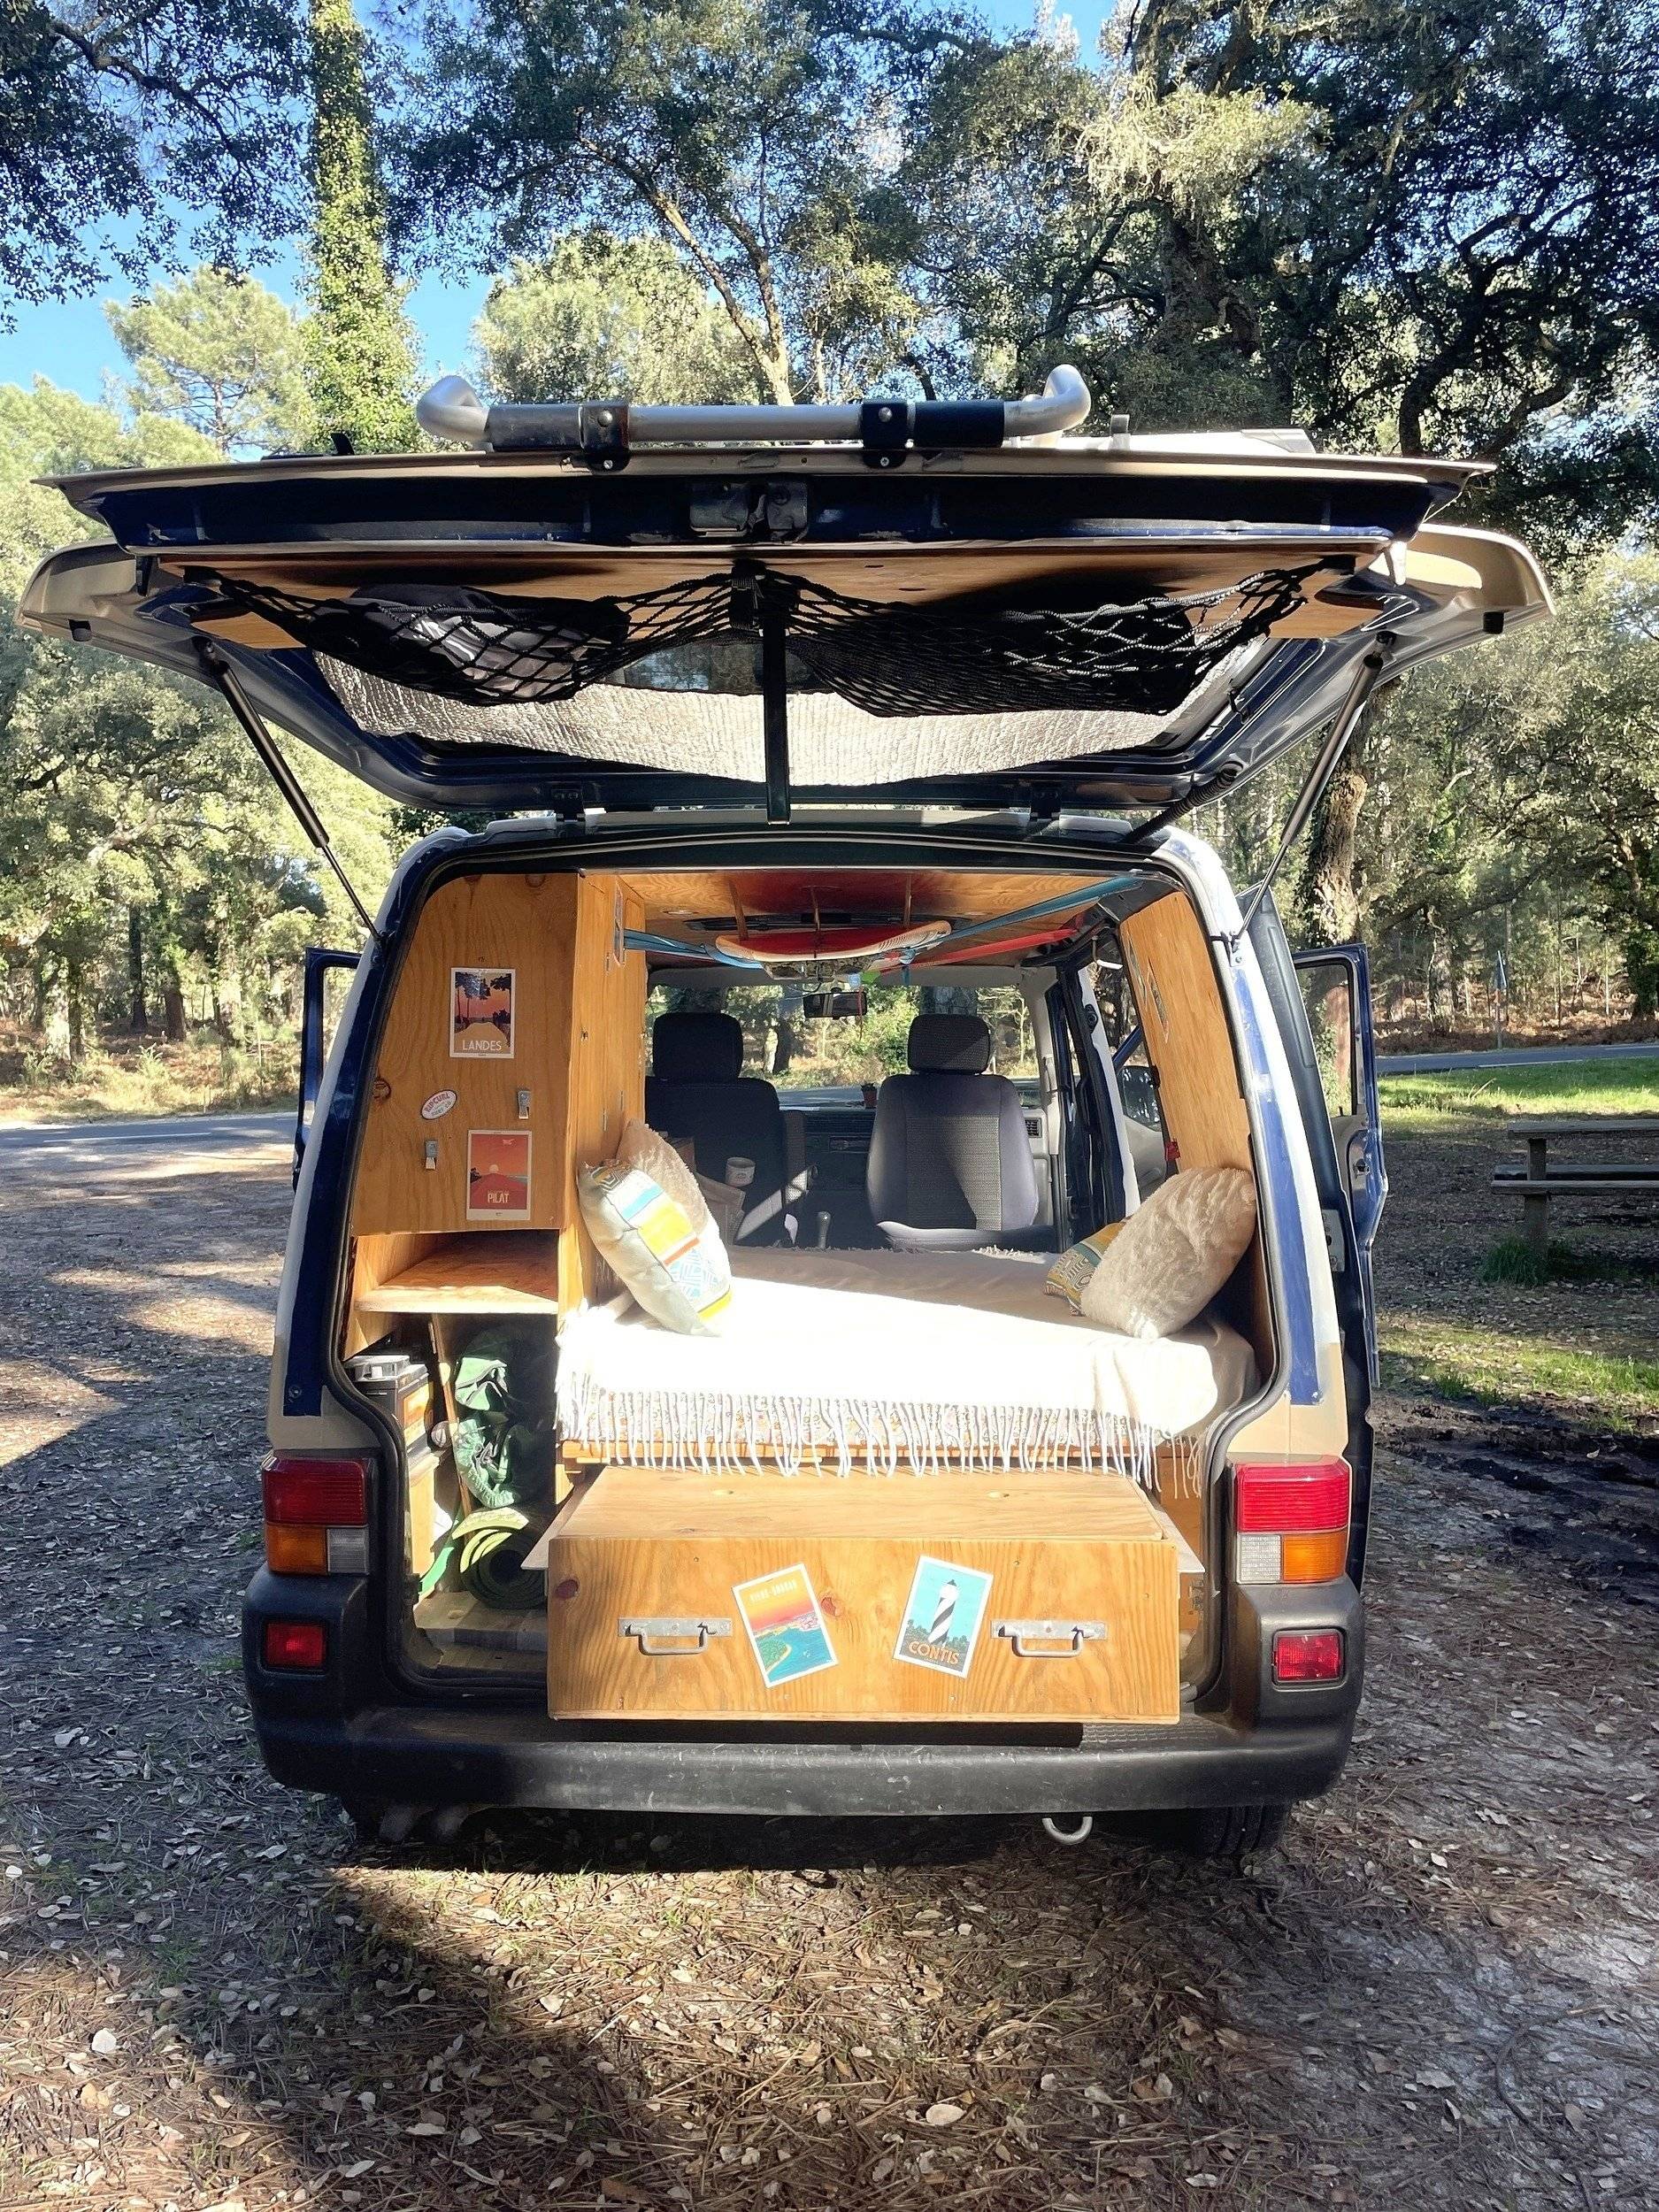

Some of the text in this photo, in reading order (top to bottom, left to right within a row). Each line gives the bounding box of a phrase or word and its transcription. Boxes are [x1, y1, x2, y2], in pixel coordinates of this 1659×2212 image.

[462, 1040, 503, 1051] LANDES
[488, 1191, 510, 1203] PILAT
[908, 1640, 960, 1665] CONTIS
